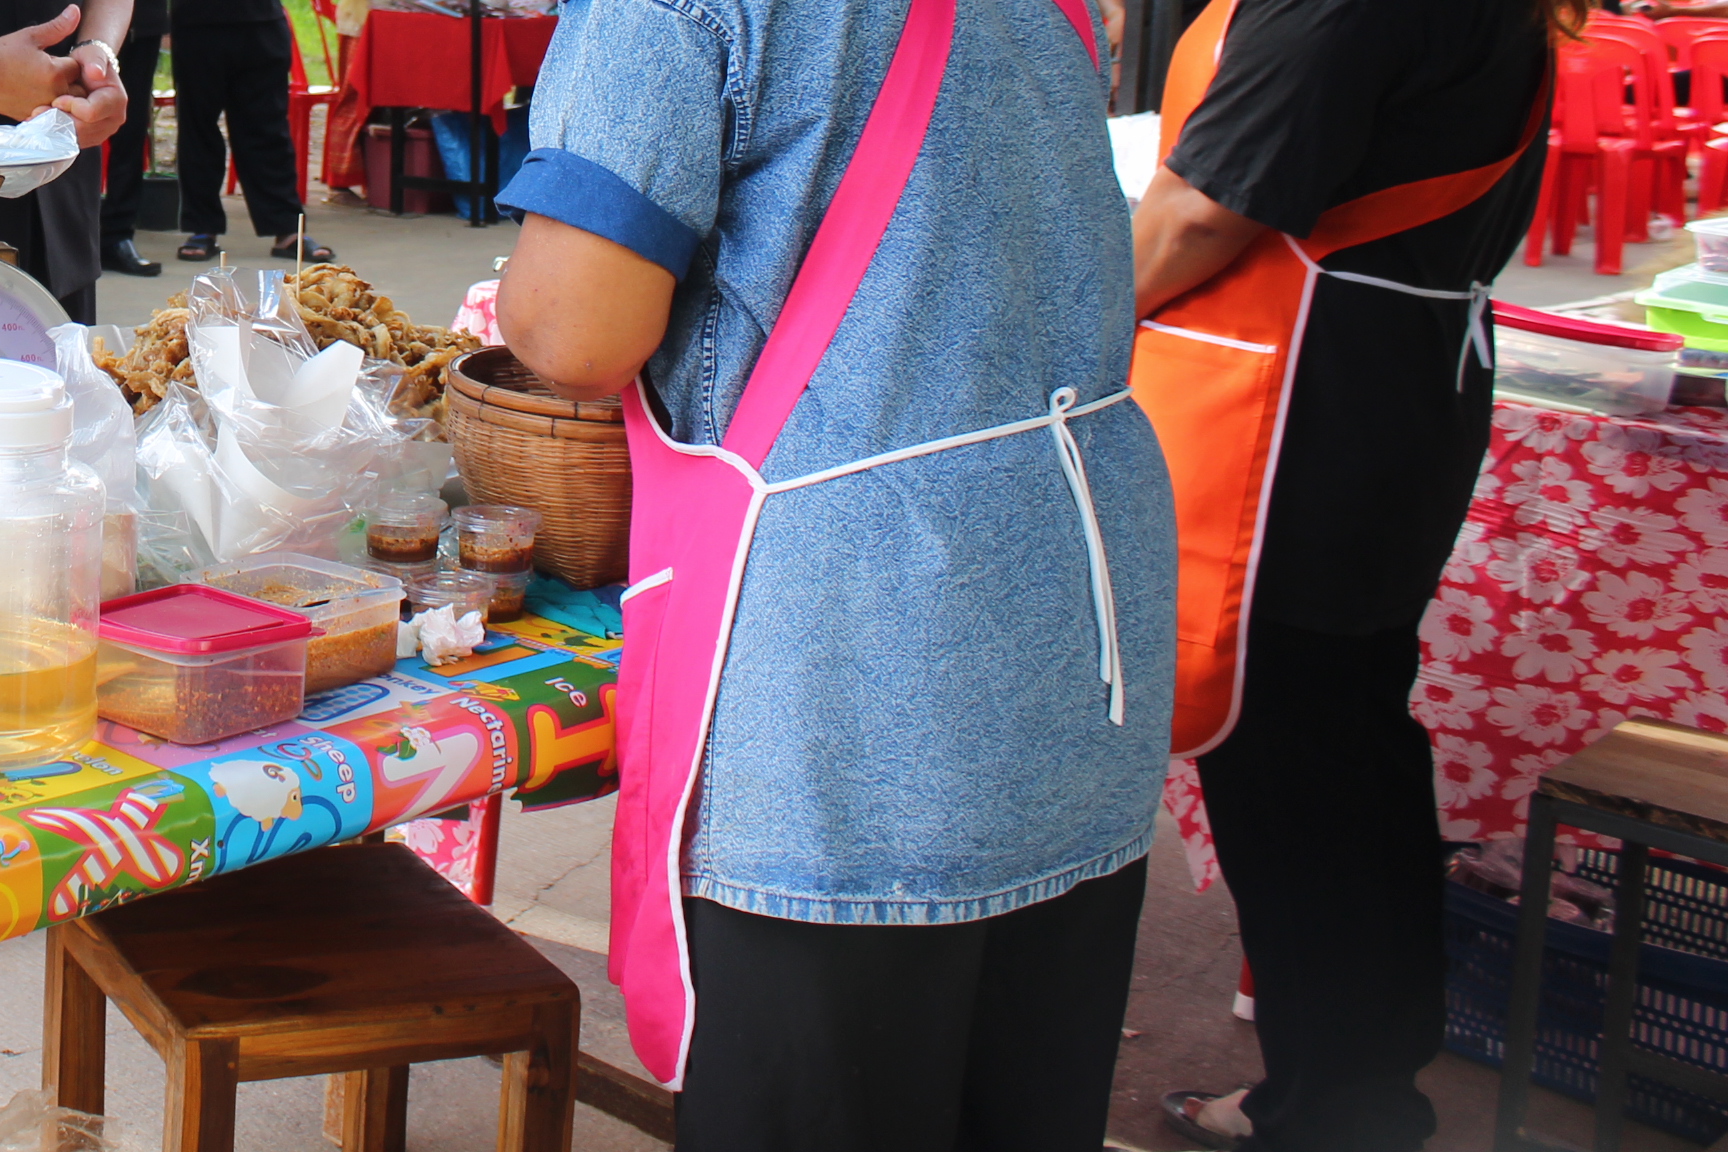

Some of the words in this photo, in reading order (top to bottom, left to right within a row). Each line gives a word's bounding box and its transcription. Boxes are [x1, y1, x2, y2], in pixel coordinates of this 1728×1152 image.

[377, 672, 442, 695] onkey
[544, 676, 589, 709] Ice
[299, 734, 358, 804] Sheep
